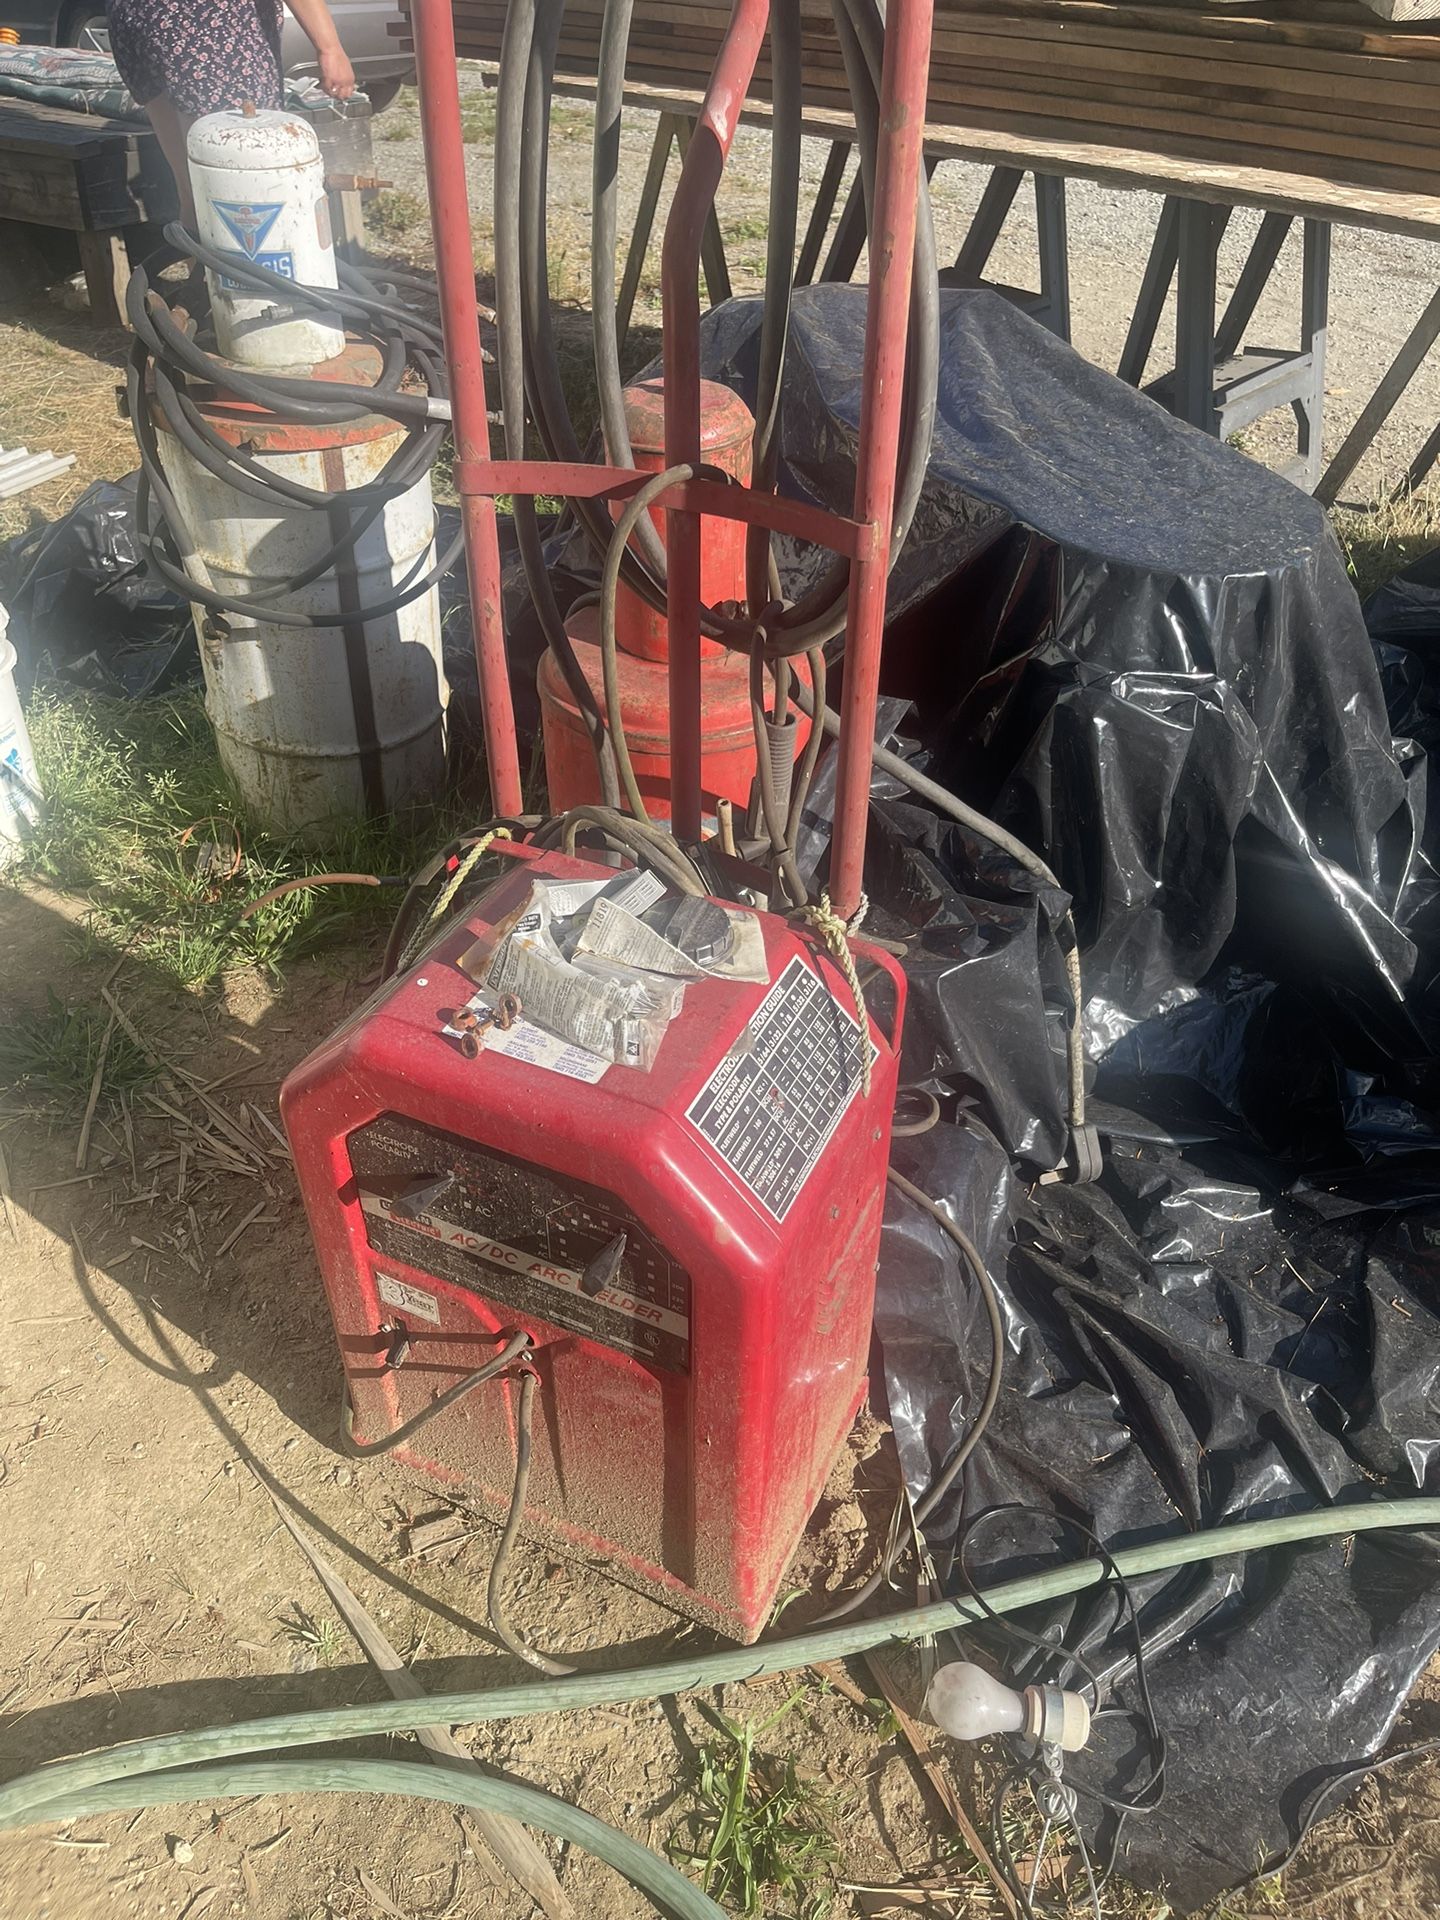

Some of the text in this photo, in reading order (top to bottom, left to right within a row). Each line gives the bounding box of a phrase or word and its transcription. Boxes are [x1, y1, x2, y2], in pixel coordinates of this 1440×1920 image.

[803, 979, 816, 996] 3/16
[792, 996, 805, 1012] 5/32
[782, 1014, 793, 1028] 1/8
[709, 985, 786, 1094] ELECTROD CTION GUIDE
[769, 1030, 782, 1048] 3/32
[714, 1075, 741, 1113] ELECTRODE
[715, 1074, 753, 1130] TYPE & POLARITY
[450, 1232, 518, 1265] AC/DC
[527, 1263, 571, 1286] ARC
